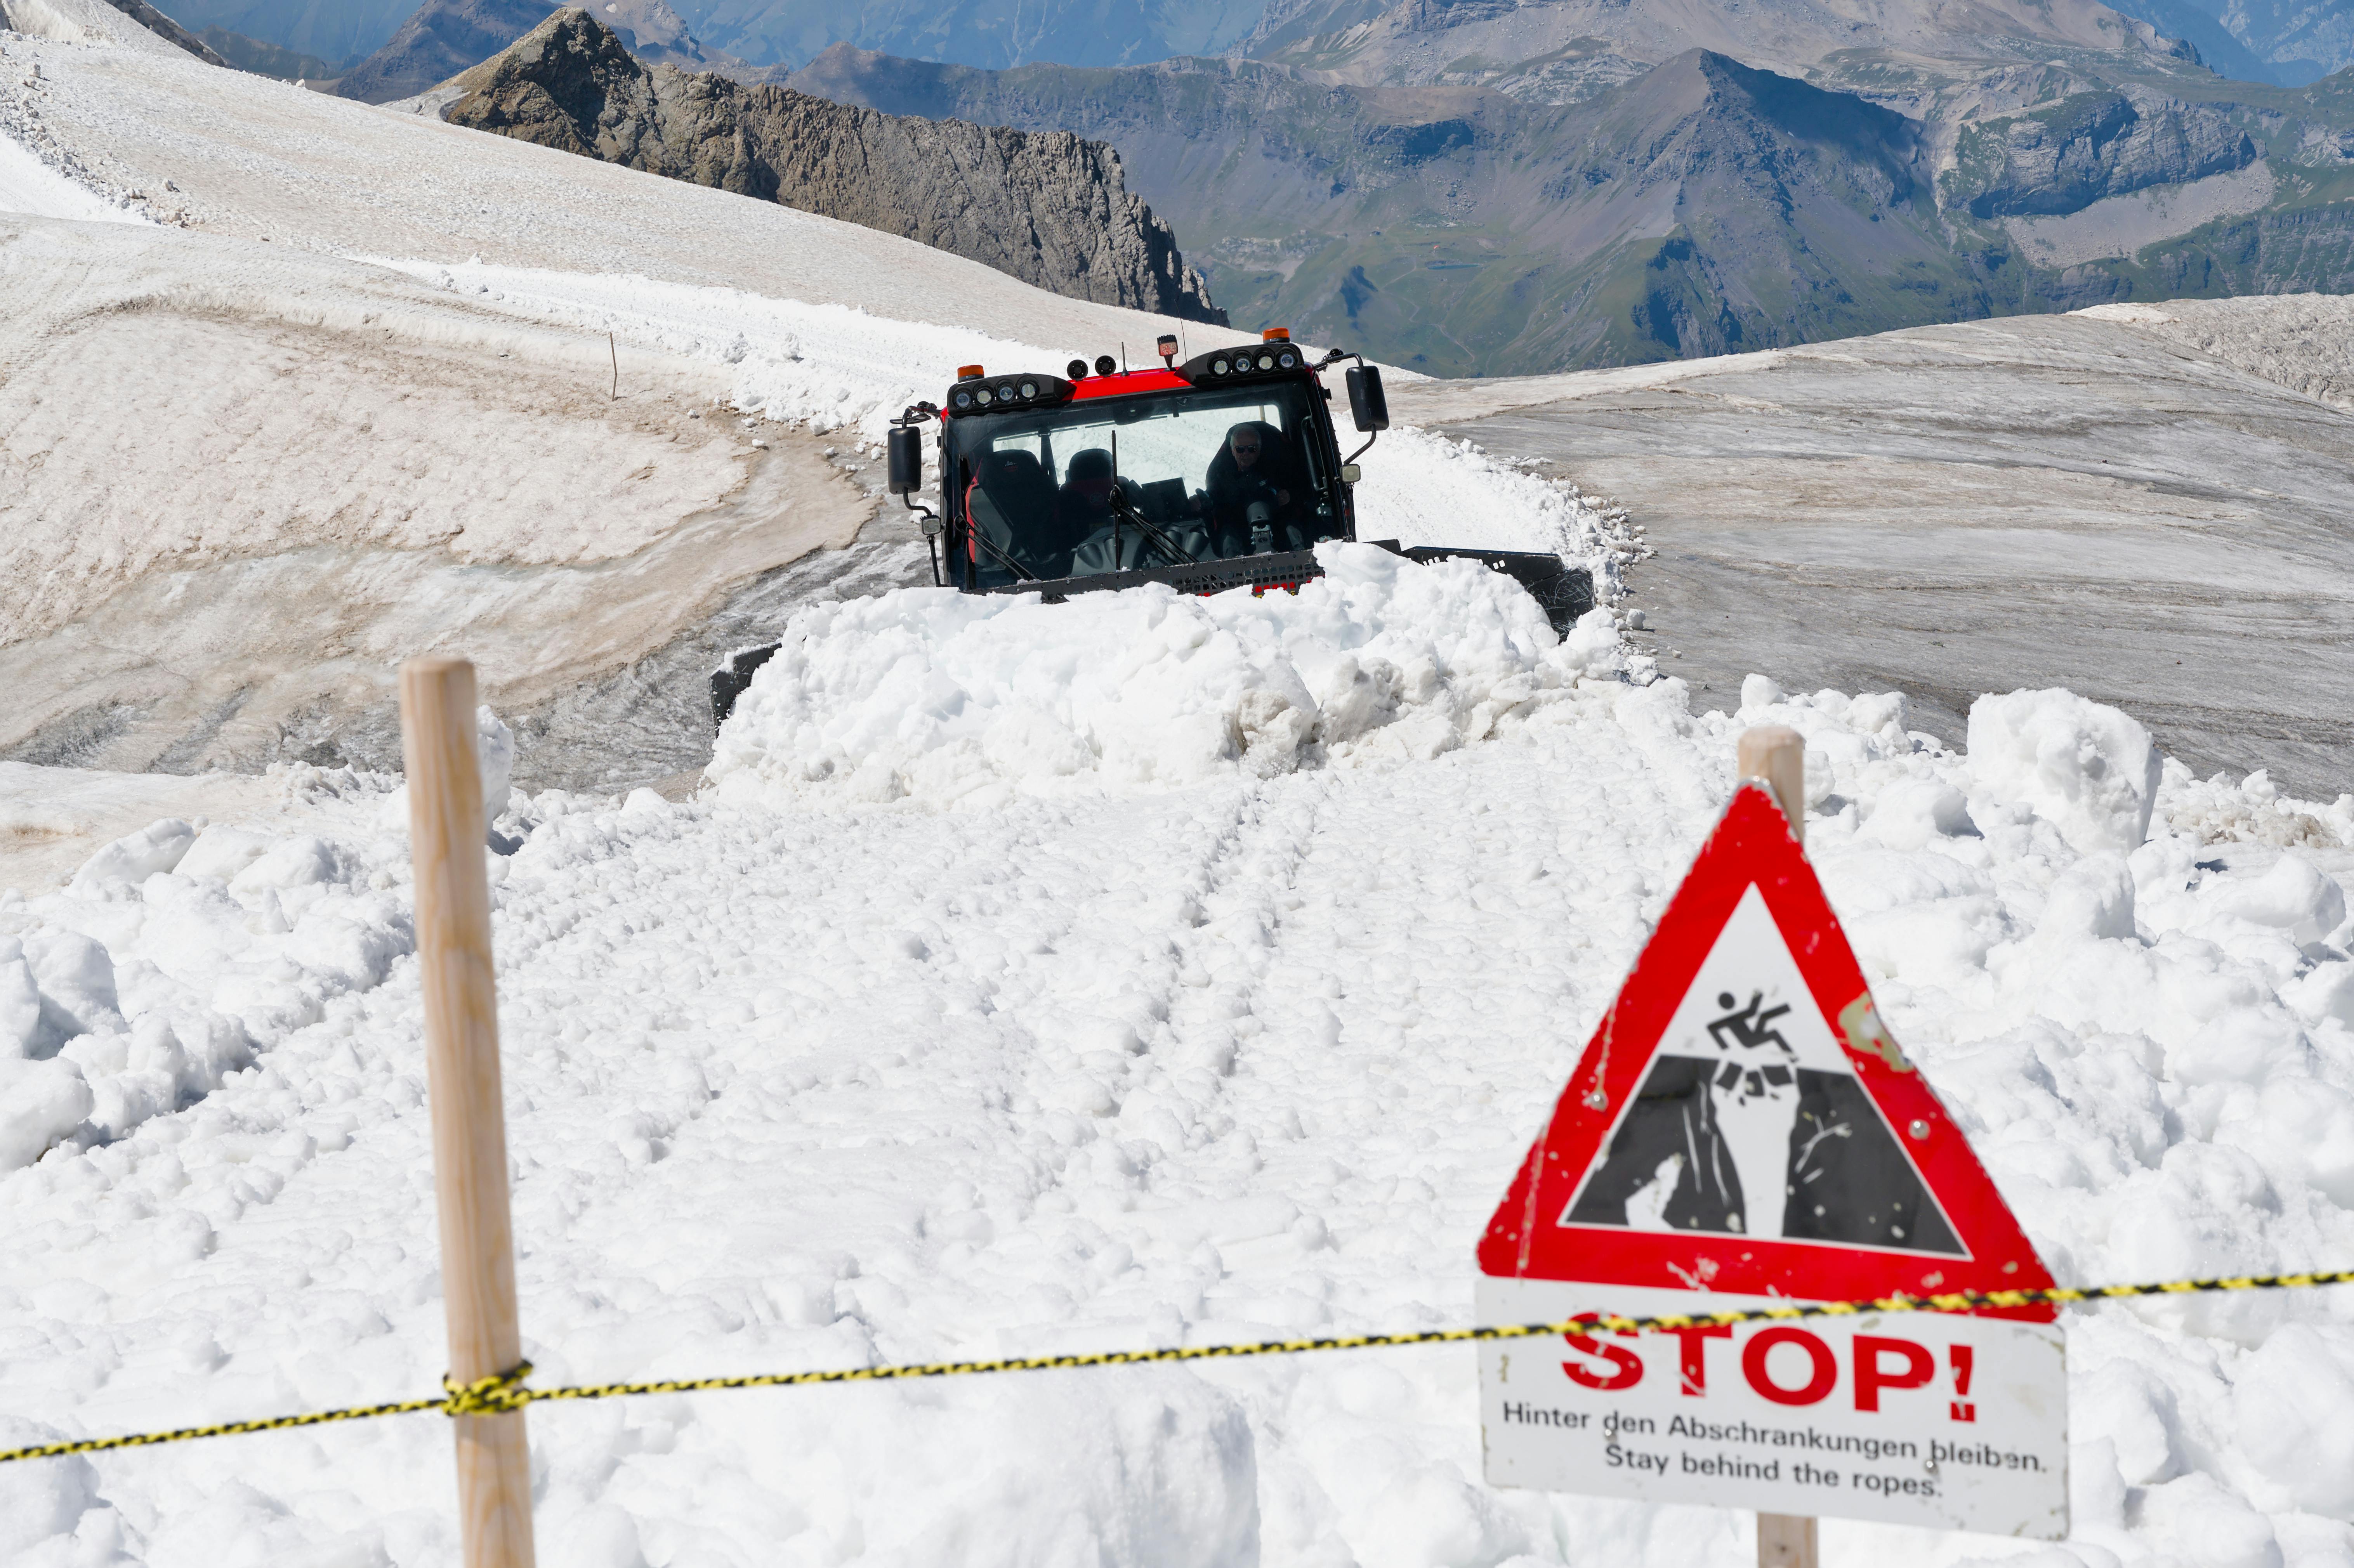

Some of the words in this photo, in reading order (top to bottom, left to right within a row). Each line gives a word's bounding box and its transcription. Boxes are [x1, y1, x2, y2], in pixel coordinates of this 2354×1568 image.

[1561, 1311, 1976, 1423] STOP!
[1503, 1401, 1591, 1429] Hinter
[1603, 1410, 1656, 1435] den
[1668, 1414, 1918, 1460] Abschrankungen
[1930, 1438, 2048, 1474] bleiben.
[1605, 1443, 1670, 1476] Stay
[1682, 1451, 1780, 1481] behind
[1792, 1462, 1840, 1487] the
[1852, 1471, 1944, 1498] ropes.
